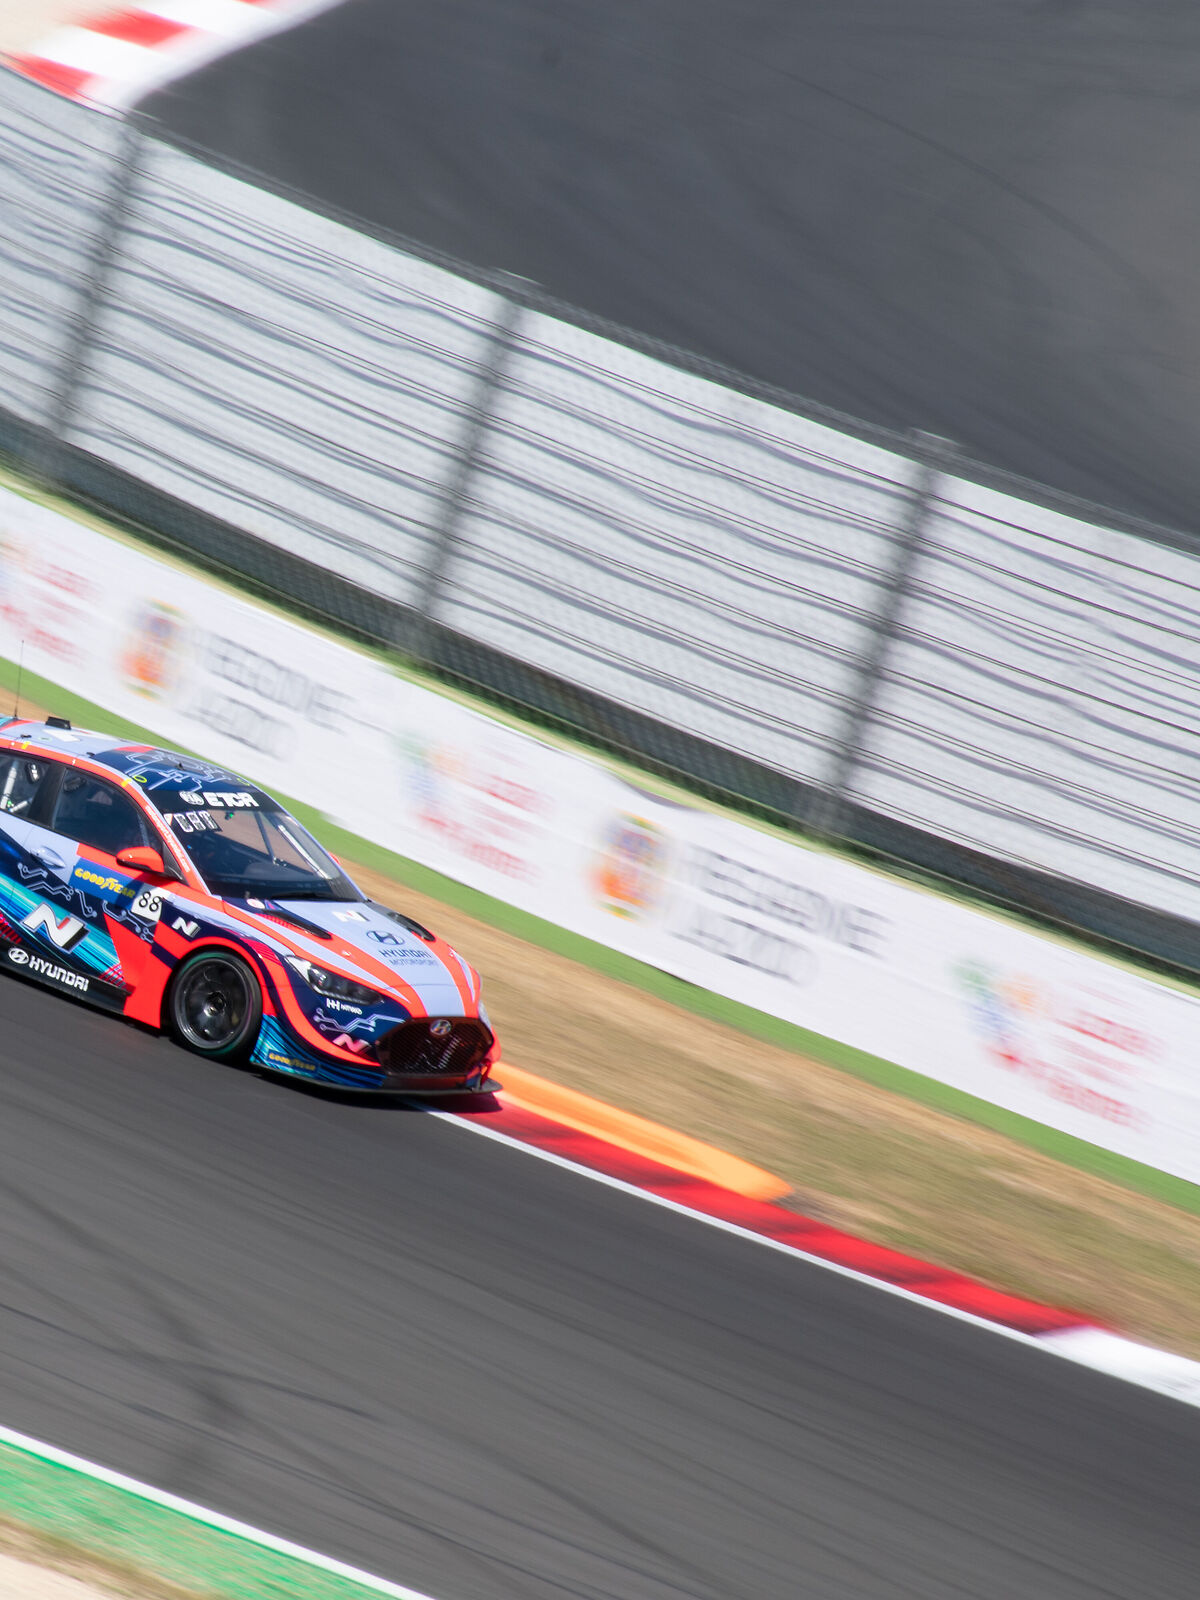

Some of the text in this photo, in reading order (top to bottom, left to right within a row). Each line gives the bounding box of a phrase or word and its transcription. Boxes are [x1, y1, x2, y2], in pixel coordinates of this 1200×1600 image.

[74, 868, 137, 899] GOODYEAR
[138, 891, 161, 912] 88
[20, 901, 90, 954] N
[172, 917, 201, 938] N
[379, 948, 433, 959] HYUNDAI
[29, 955, 90, 992] HYUNDAI
